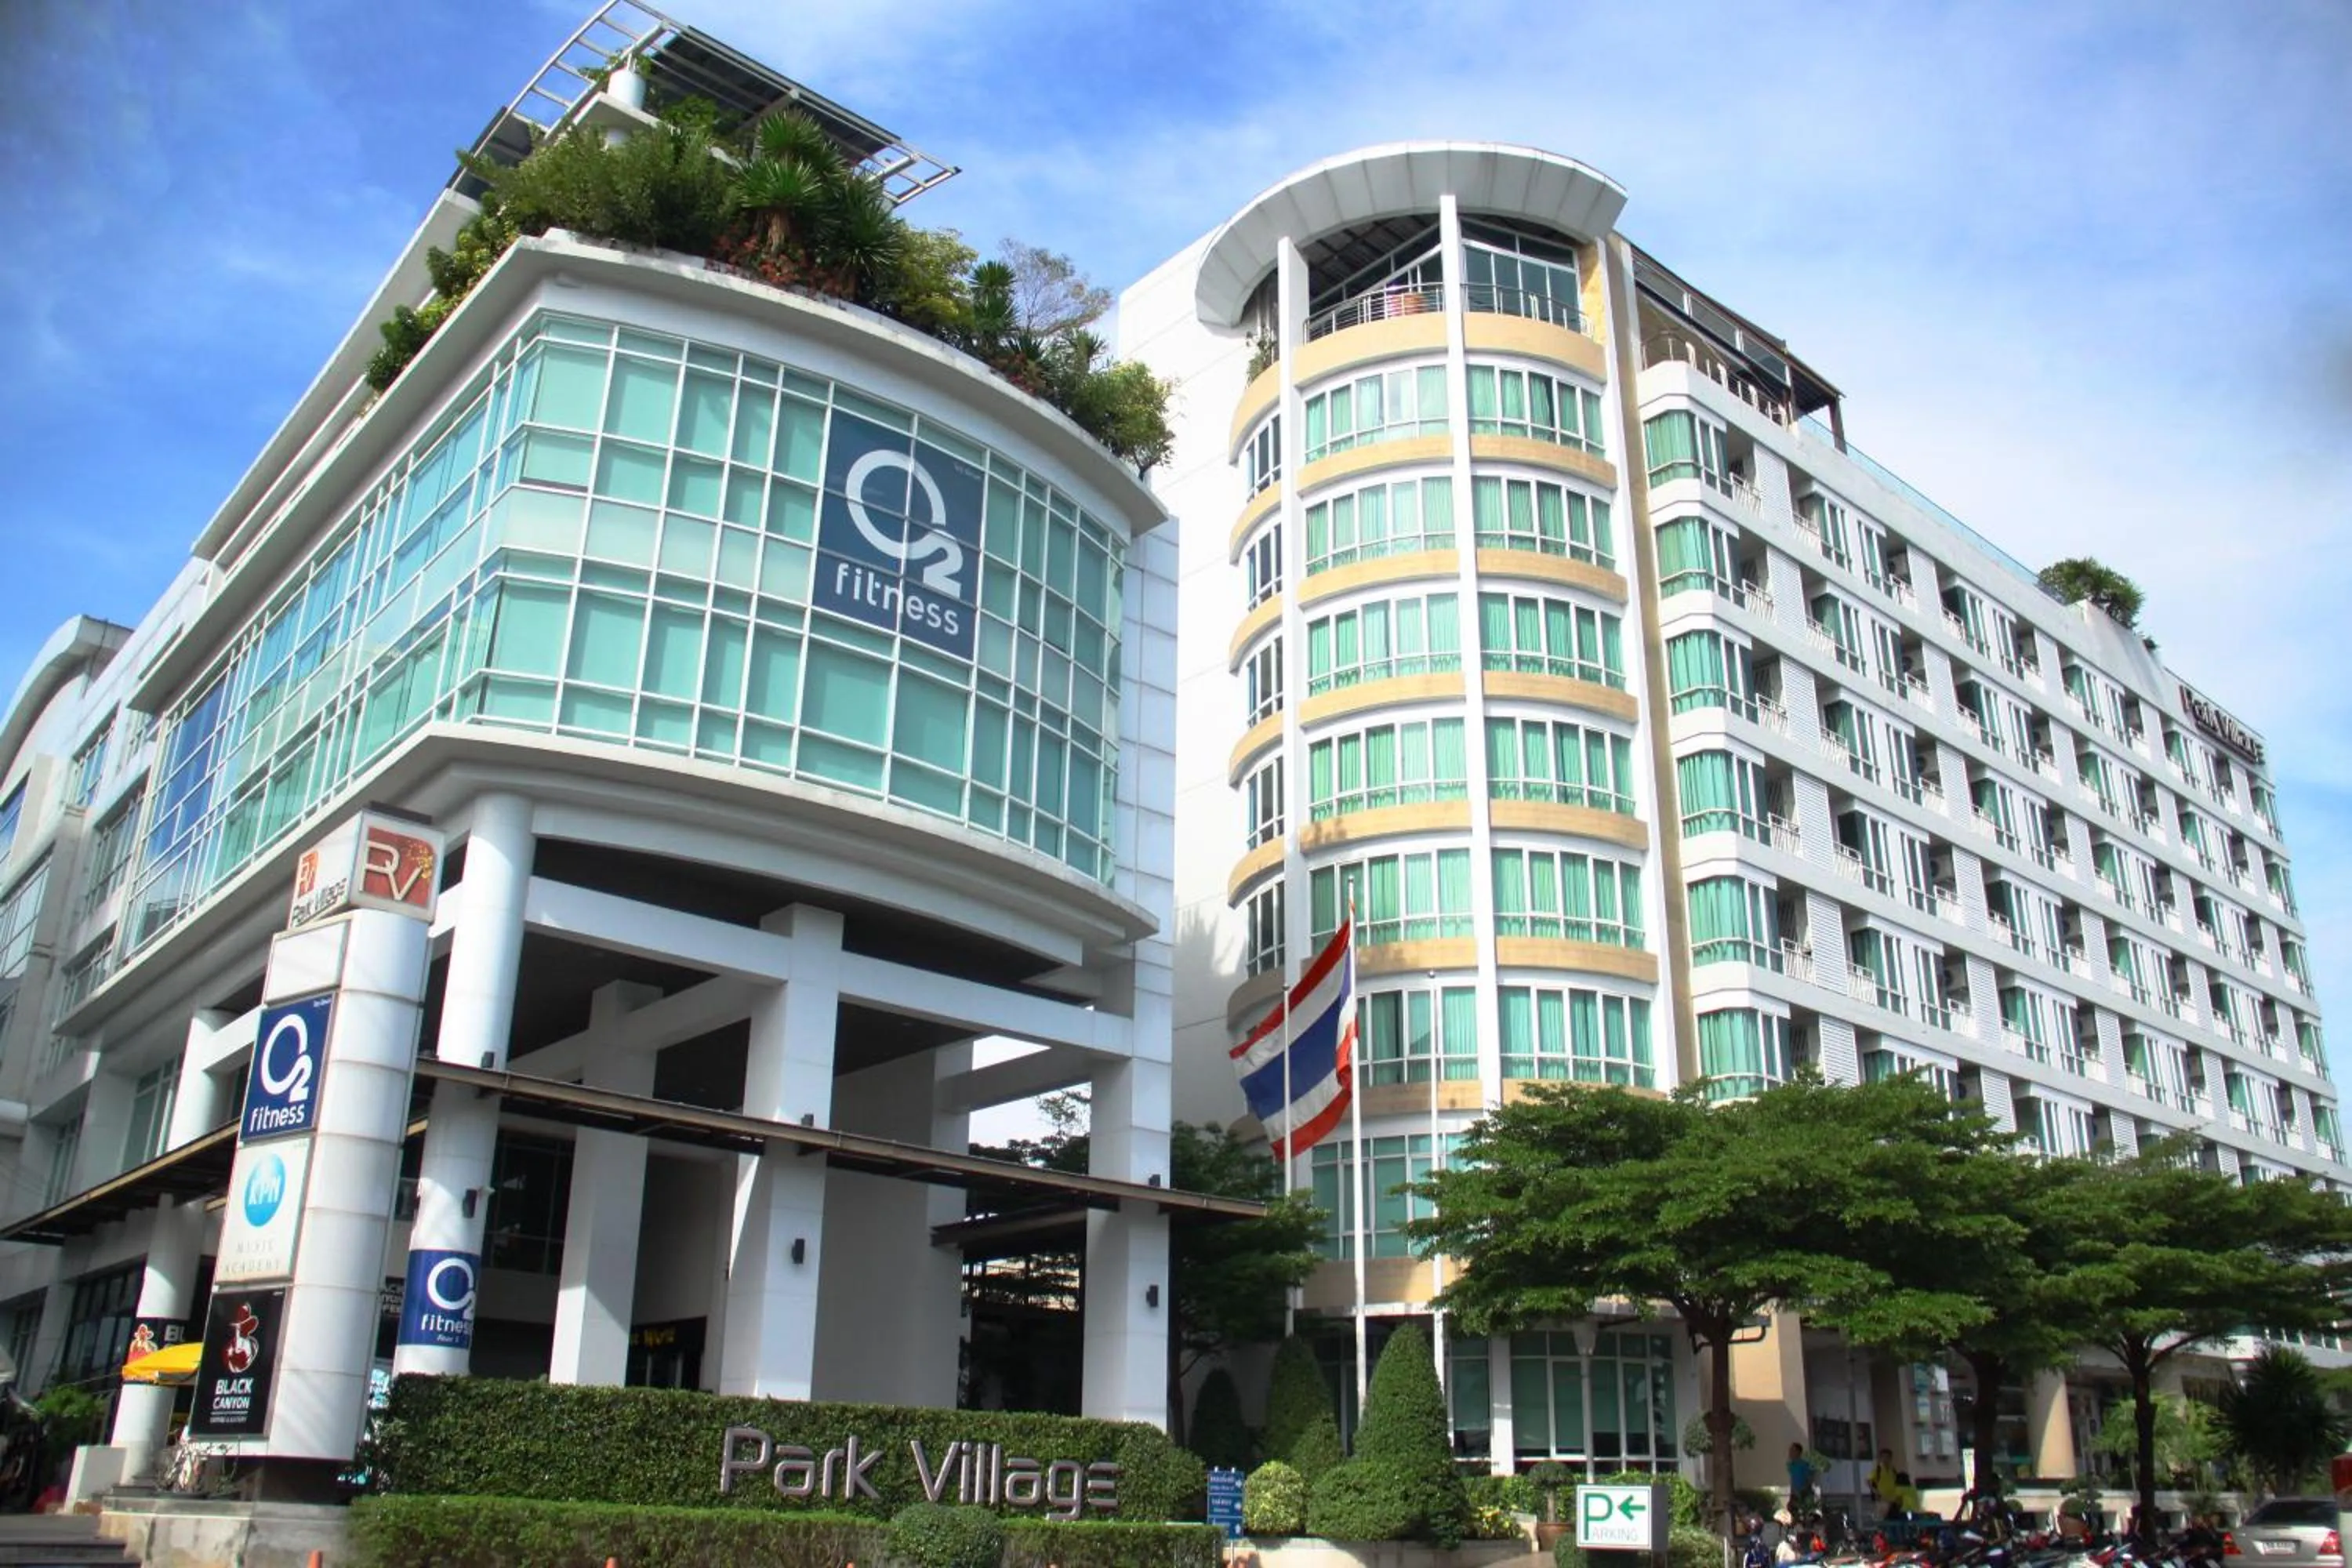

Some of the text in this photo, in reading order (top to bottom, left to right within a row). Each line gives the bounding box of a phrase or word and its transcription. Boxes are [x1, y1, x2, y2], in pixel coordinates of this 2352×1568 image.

[835, 562, 959, 636] fitness
[261, 1014, 313, 1104] O2
[249, 1103, 306, 1132] fitness
[249, 1175, 281, 1205] KPN
[421, 1313, 474, 1334] fitnes
[215, 1377, 254, 1396] BLACK
[212, 1396, 250, 1410] CANYON
[720, 1426, 1120, 1520] Park Village
